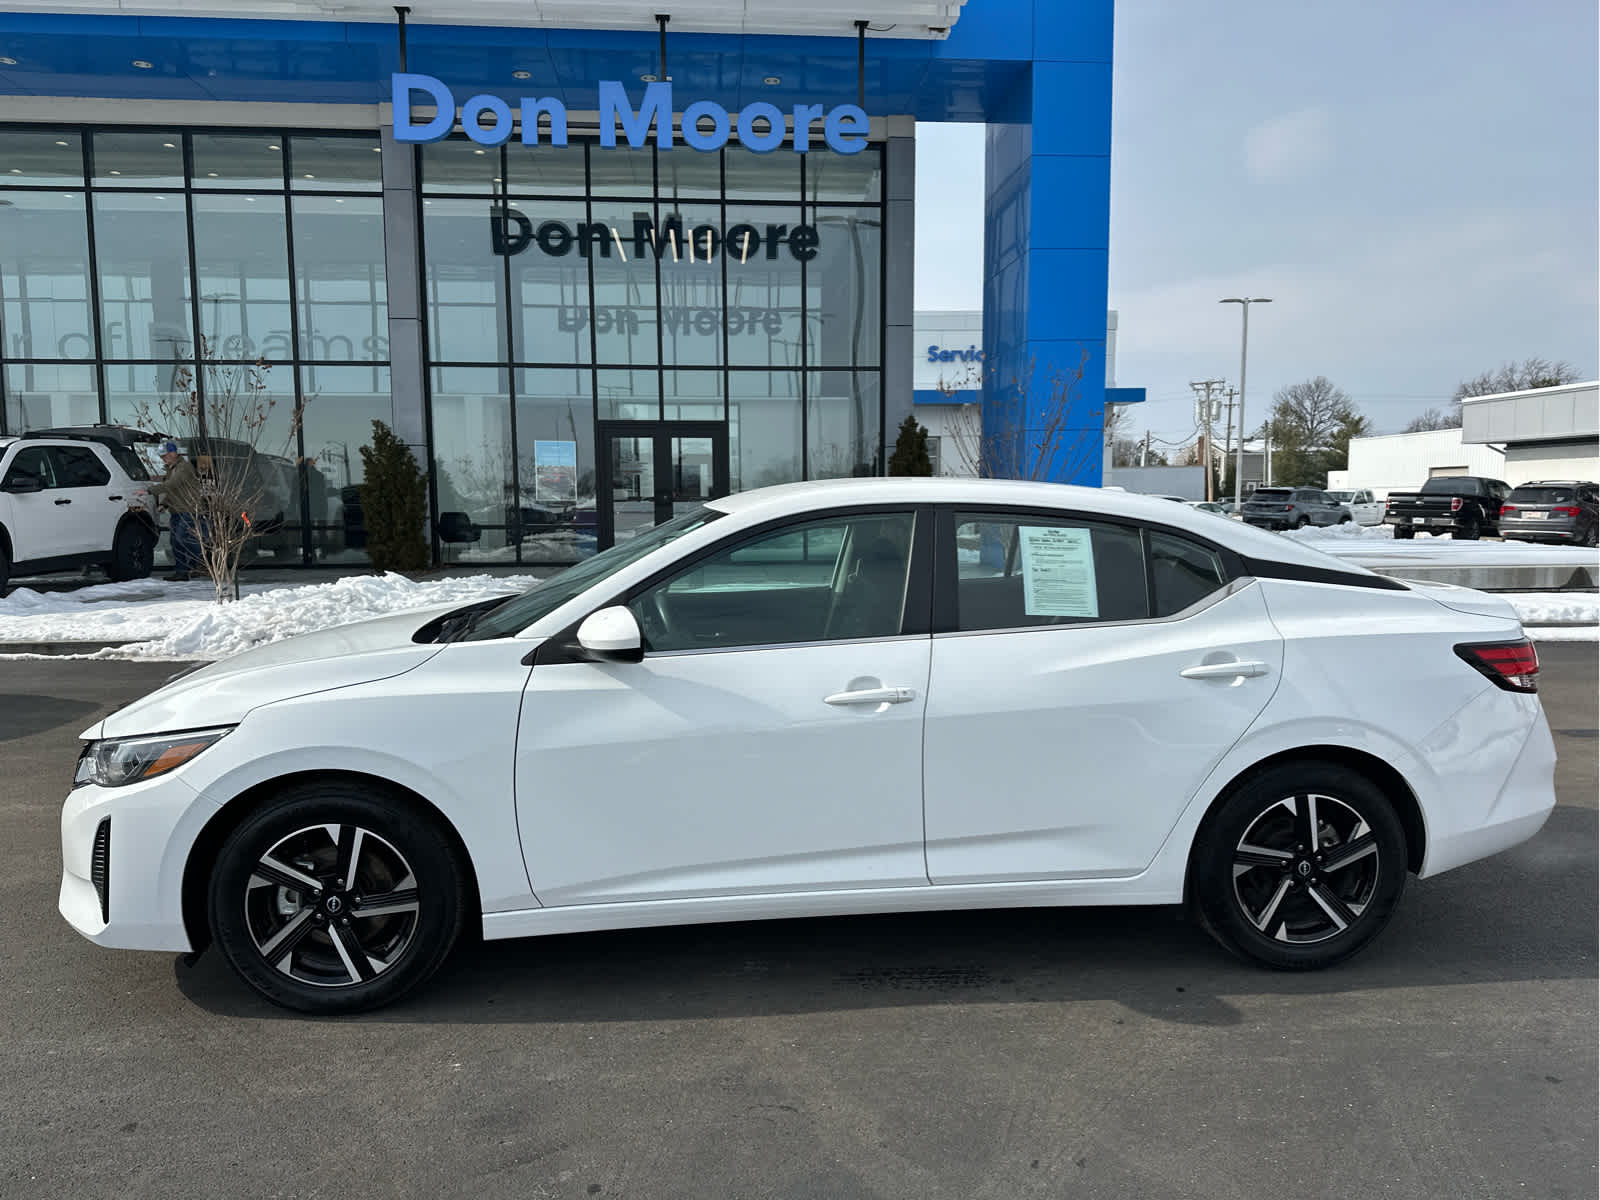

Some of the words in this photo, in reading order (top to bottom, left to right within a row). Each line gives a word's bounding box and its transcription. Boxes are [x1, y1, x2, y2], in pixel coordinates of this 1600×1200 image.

[392, 73, 568, 147] Don
[599, 80, 870, 156] Moore
[490, 206, 611, 257] Don
[632, 211, 820, 262] Moore
[927, 345, 984, 362] Servic
